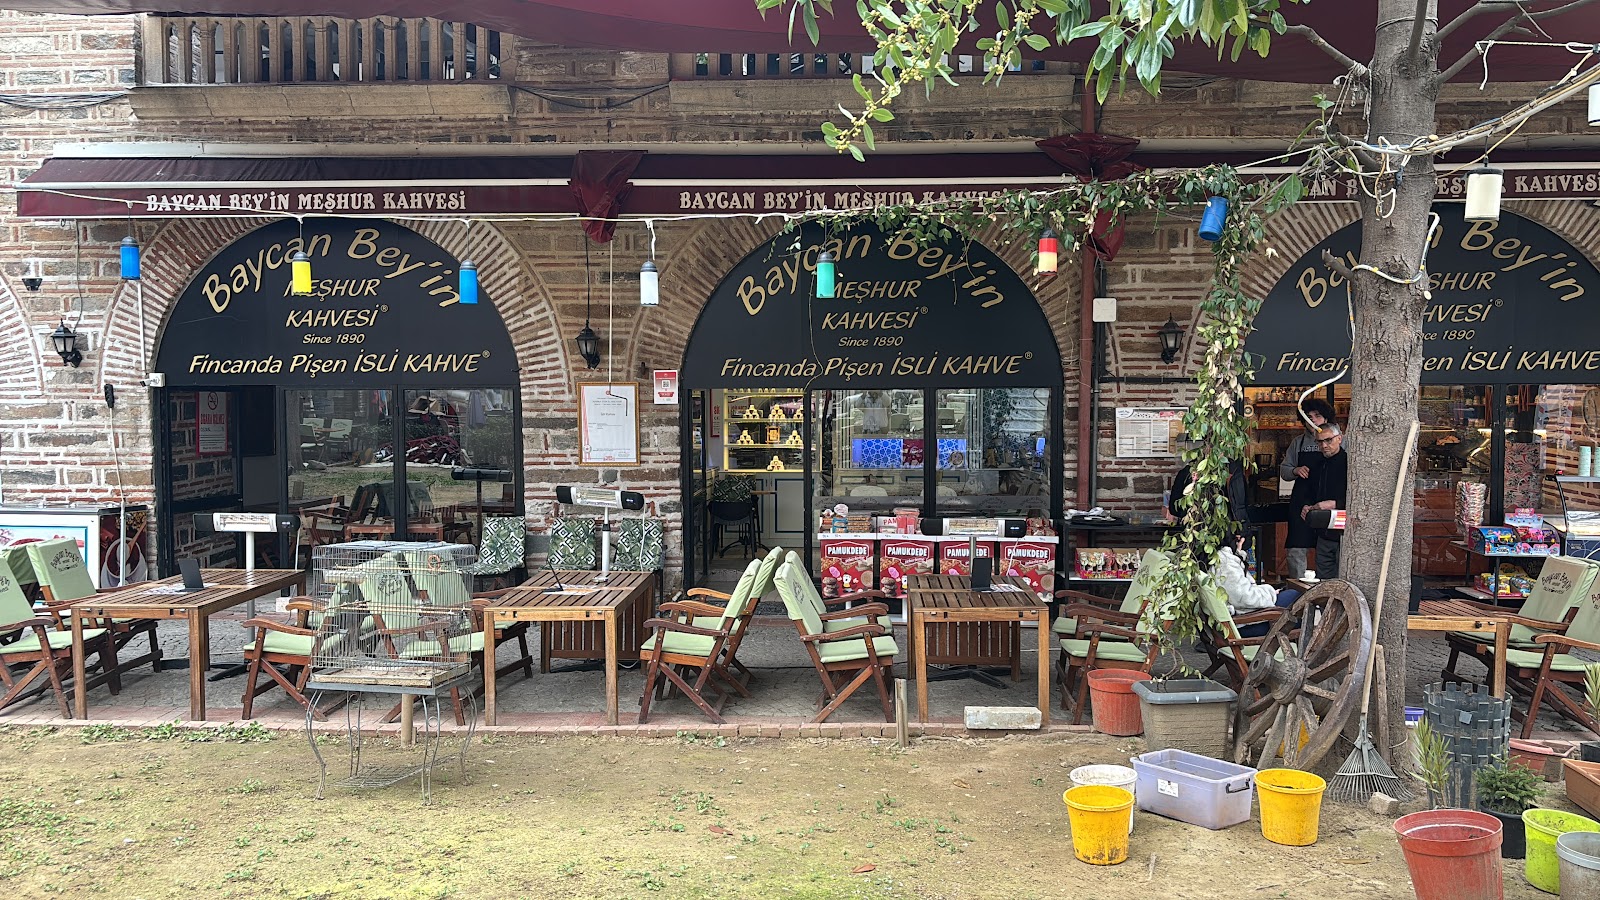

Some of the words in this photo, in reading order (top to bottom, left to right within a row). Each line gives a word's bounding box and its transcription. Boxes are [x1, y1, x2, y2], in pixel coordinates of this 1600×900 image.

[146, 194, 222, 212] BAYCAN
[297, 192, 376, 213] MEŞHUR
[383, 190, 466, 210] KAHVESİ
[680, 191, 756, 209] BAYCAN
[202, 233, 332, 314] Baycan
[347, 228, 461, 308] Bey'in
[1460, 220, 1585, 302] Bey'in
[736, 234, 872, 316] Baycan
[303, 333, 332, 344] Since
[336, 333, 365, 344] 1890
[838, 336, 869, 347] Since
[873, 336, 904, 347] 1890
[1442, 329, 1476, 341] 1890
[189, 353, 283, 374] Fincanda
[290, 353, 347, 378] Pişen
[354, 349, 399, 373] İSLİ
[720, 358, 817, 377] Fincanda
[824, 357, 884, 382] Pişen
[890, 352, 938, 375] İSLİ
[1460, 345, 1513, 371] İSLİ
[827, 546, 868, 555] PAMUKDEDE
[887, 546, 928, 557] PAMUKDEDE
[1007, 548, 1049, 559] PAMUKDEDE
